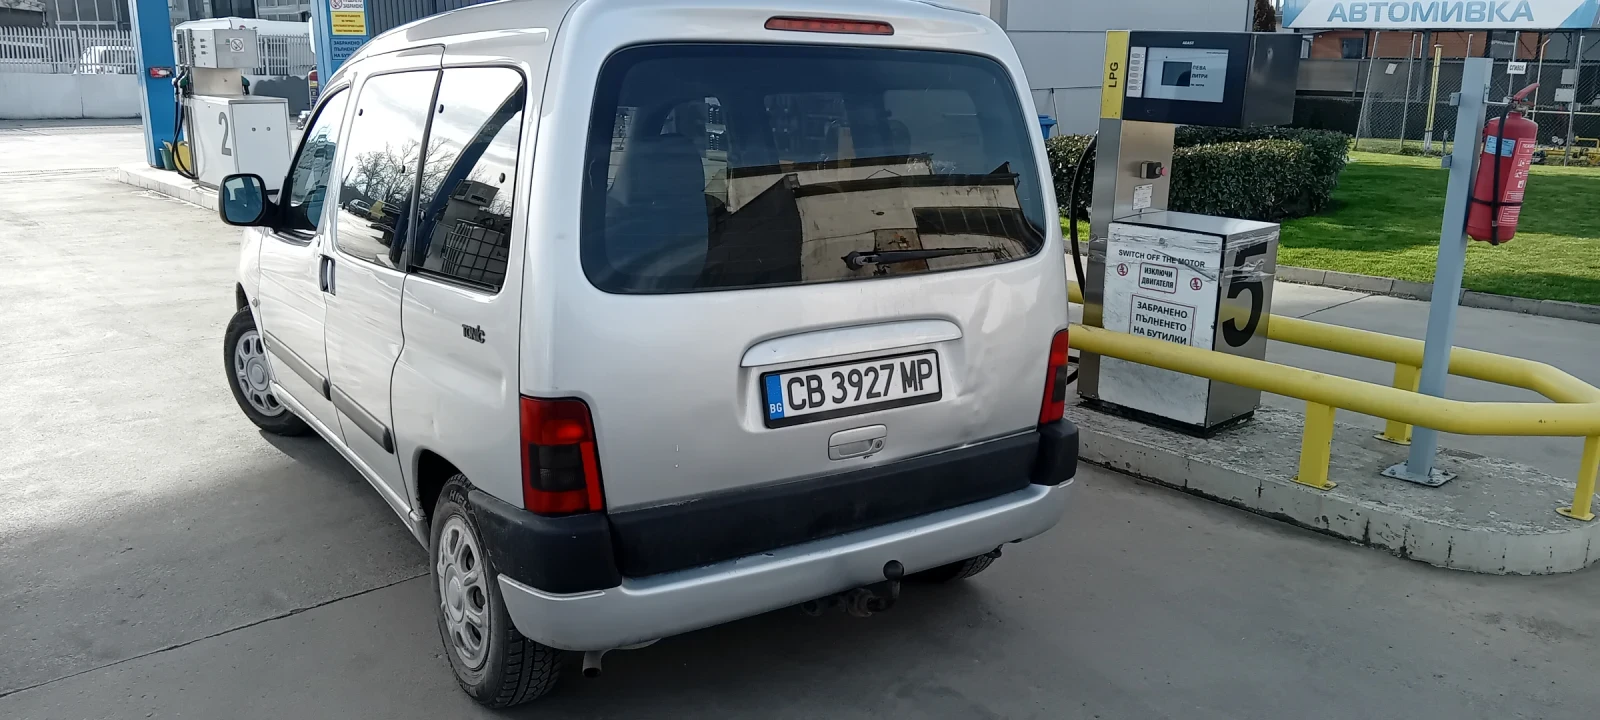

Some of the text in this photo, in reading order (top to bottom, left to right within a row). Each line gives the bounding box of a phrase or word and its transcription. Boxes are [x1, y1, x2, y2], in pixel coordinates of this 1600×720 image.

[1327, 1, 1534, 22] АВТОМИВКА
[1108, 62, 1118, 88] LPG
[218, 112, 232, 156] 2
[1119, 249, 1205, 268] SWITCH OFF THE MOTOR
[1144, 267, 1173, 278] ИЗКЛЮЧИ
[1141, 277, 1174, 288] ДВИГАТЕЛЯ
[1222, 242, 1267, 347] 5
[1137, 301, 1188, 318] ЗАБРАНЕНО
[1135, 313, 1187, 331] ПЪЛНЕНЕТО
[1133, 326, 1187, 345] НА БУТИЛКИ
[769, 358, 932, 414] BG CB 3927 MP
